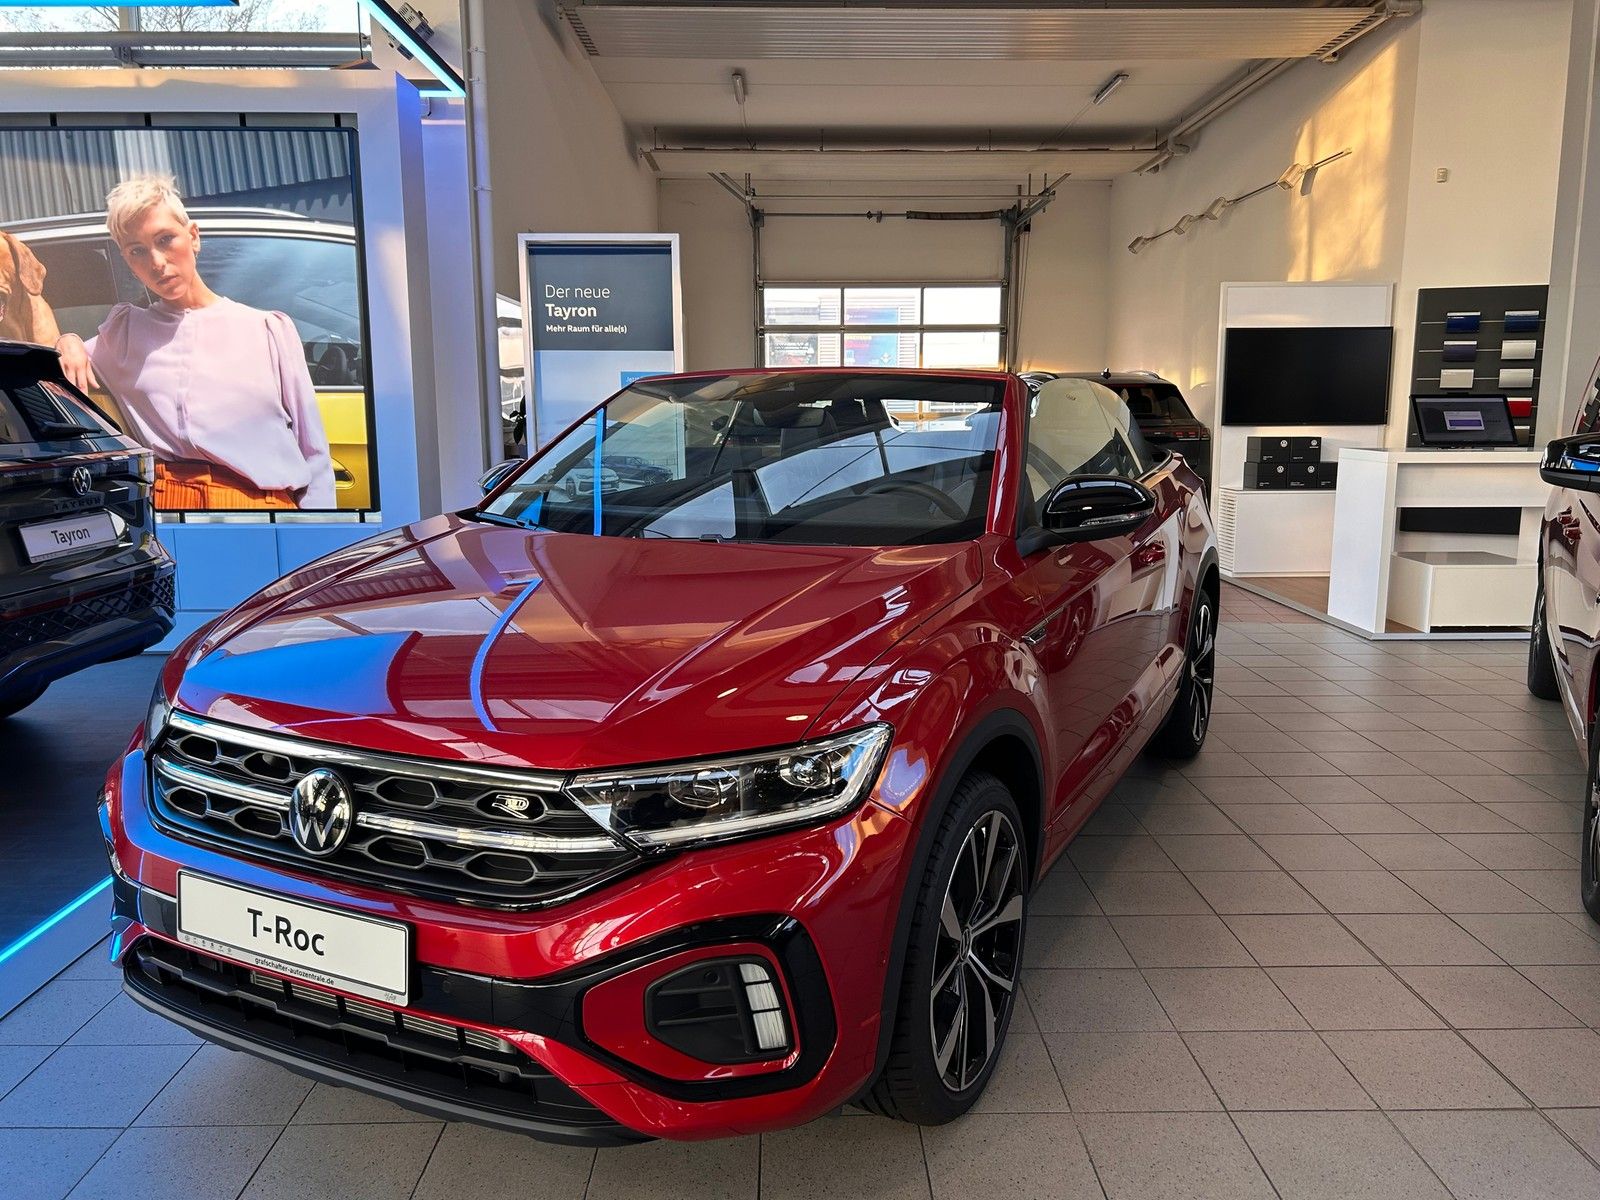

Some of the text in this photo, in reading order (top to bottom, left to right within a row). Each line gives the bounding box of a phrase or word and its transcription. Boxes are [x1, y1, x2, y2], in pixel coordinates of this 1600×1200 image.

[545, 285, 611, 298] Der neue
[545, 304, 597, 320] Tayron
[546, 324, 628, 334] Mehr Raum für alle(s)
[51, 527, 91, 546] Tayron
[247, 908, 325, 956] T-Roc
[255, 957, 335, 986] grafschafter-autozentrale.de
